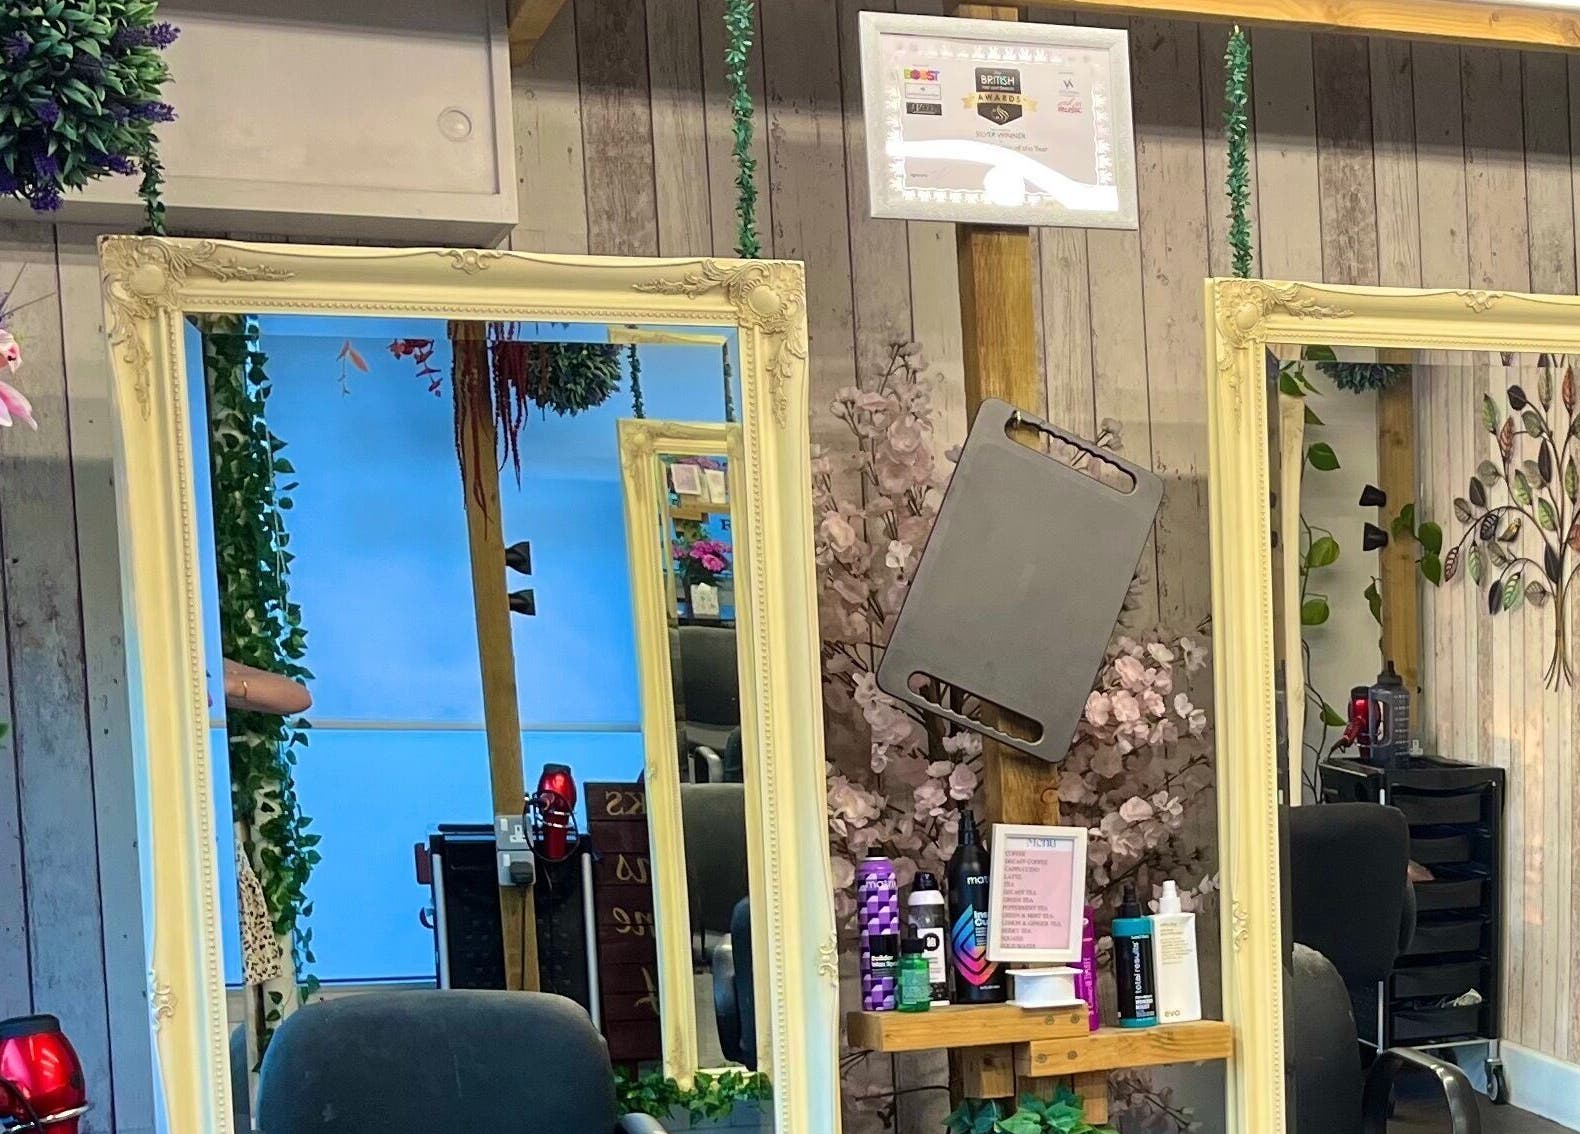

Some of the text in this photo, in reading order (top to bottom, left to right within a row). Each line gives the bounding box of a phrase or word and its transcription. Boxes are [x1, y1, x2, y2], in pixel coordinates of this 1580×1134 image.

[980, 75, 1015, 86] BRITISH
[978, 94, 1021, 102] AWARDS
[1134, 973, 1142, 994] total
